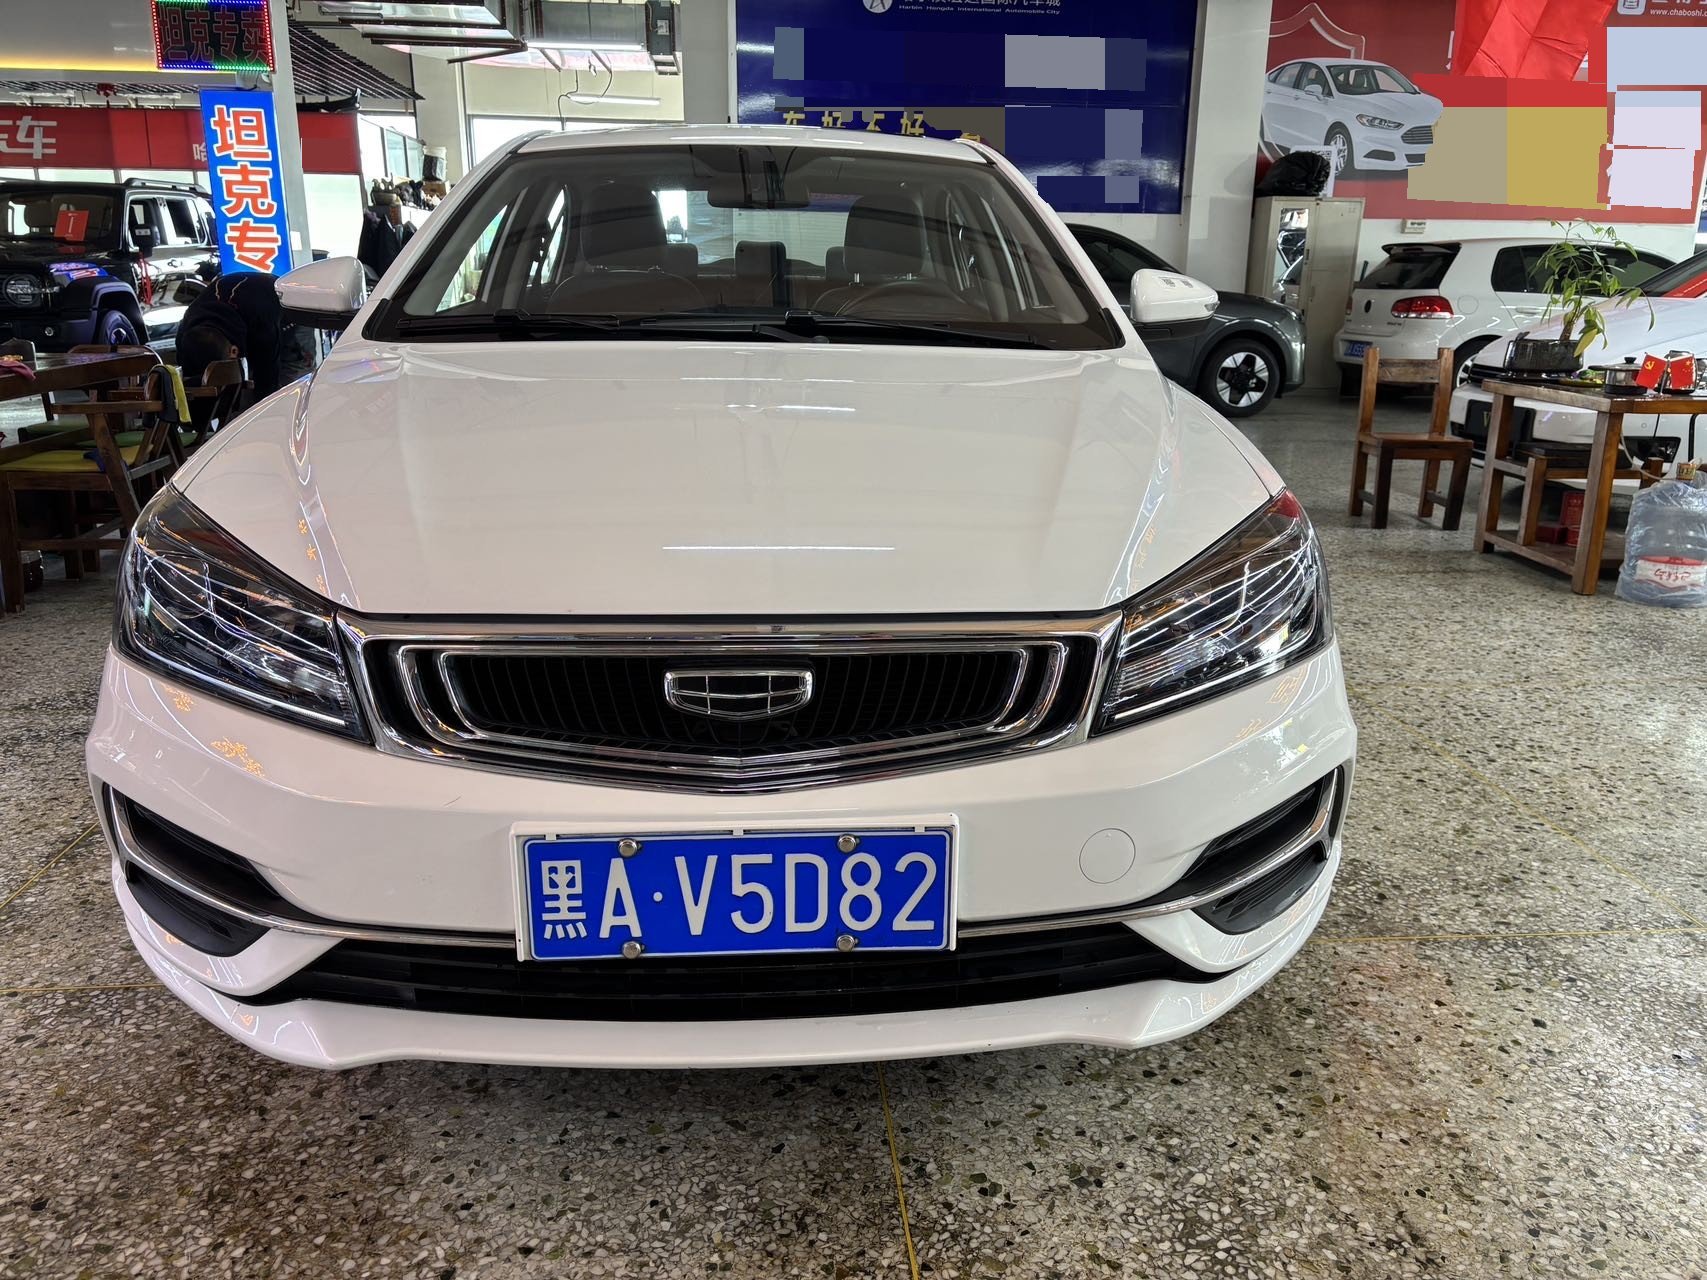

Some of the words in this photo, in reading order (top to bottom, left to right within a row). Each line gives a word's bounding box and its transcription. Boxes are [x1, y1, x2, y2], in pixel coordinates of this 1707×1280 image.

[158, 4, 269, 64] 坦克专卖
[211, 105, 282, 274] 坦克专
